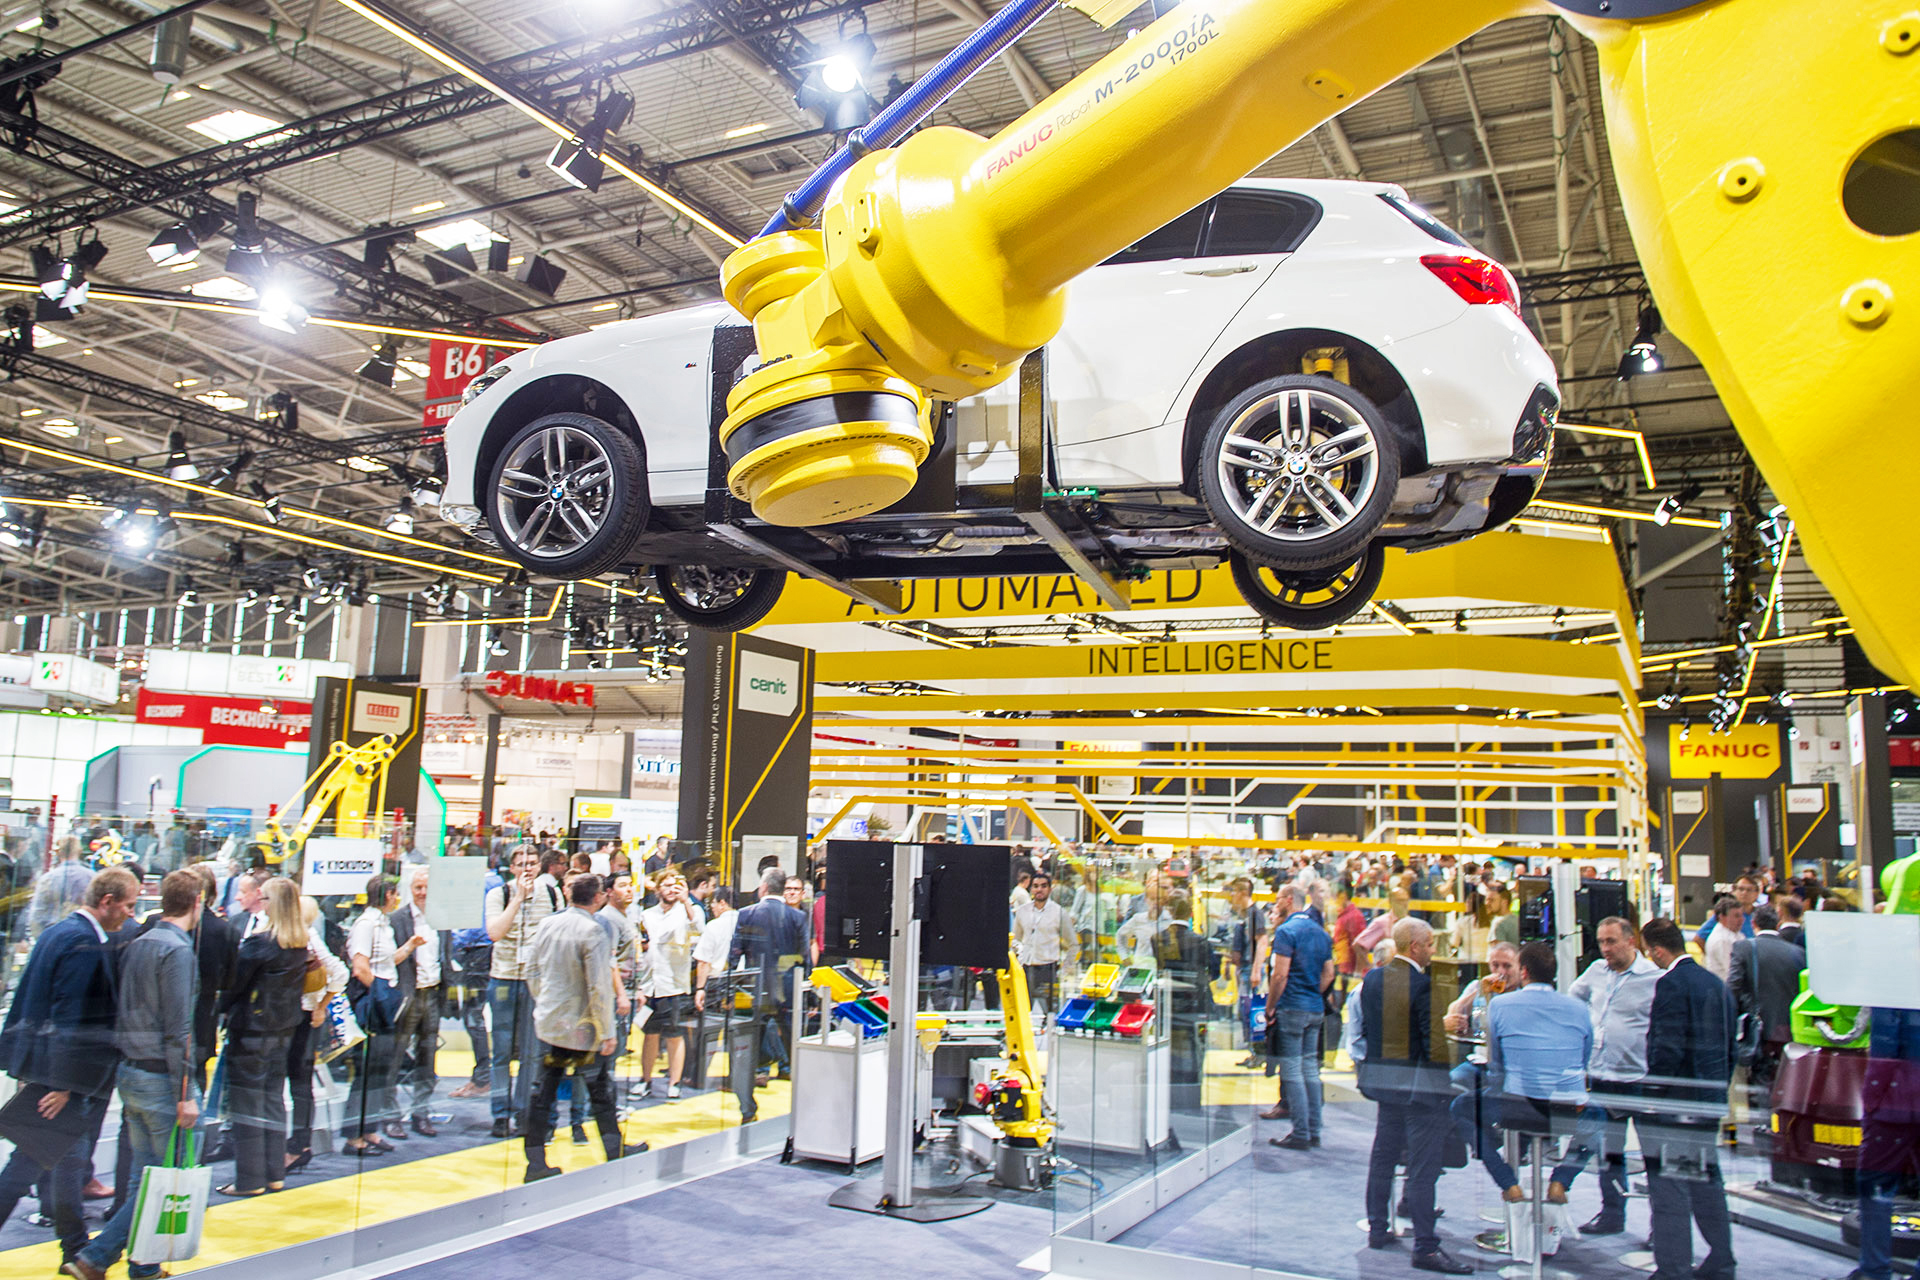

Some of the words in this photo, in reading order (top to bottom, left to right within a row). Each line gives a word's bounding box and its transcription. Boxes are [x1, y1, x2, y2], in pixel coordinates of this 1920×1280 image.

[1170, 31, 1219, 65] 1700L
[986, 124, 1053, 179] FANUC
[1095, 13, 1216, 104] M-2000iA
[444, 344, 482, 380] B6
[712, 645, 724, 702] Validierung
[1089, 640, 1333, 675] INTELLIGENCE
[750, 677, 787, 695] cenit
[145, 705, 186, 718] BECKHOFF
[711, 703, 720, 725] PLC
[1679, 744, 1771, 758] FANUC
[706, 732, 720, 820] Programmierung
